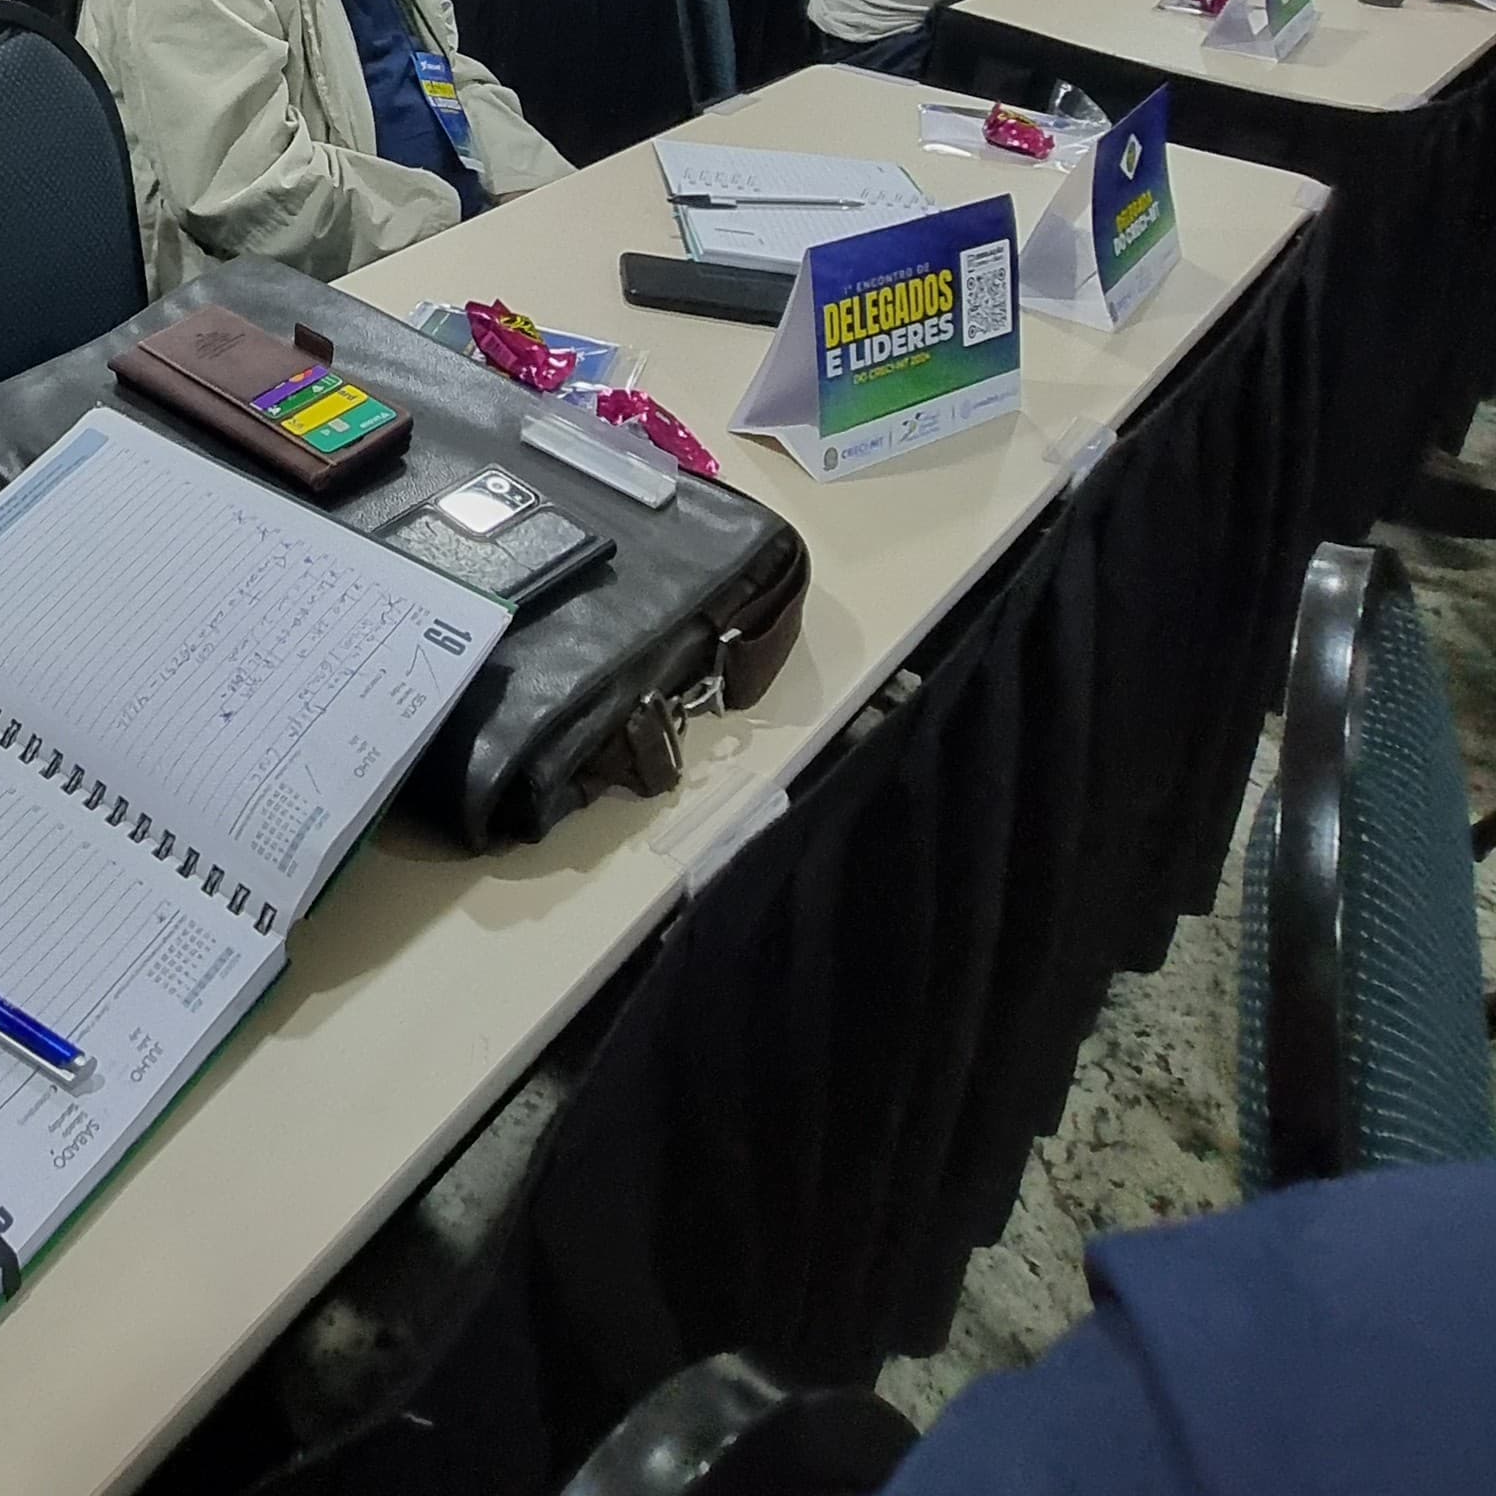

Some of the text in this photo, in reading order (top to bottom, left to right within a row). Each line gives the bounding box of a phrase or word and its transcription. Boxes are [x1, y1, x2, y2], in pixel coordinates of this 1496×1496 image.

[824, 269, 953, 348] DELEGADOS
[826, 313, 954, 378] E LIDERES
[423, 617, 473, 657] 19
[127, 1039, 166, 1085] JULHO
[50, 1117, 101, 1171] SÁBADO
